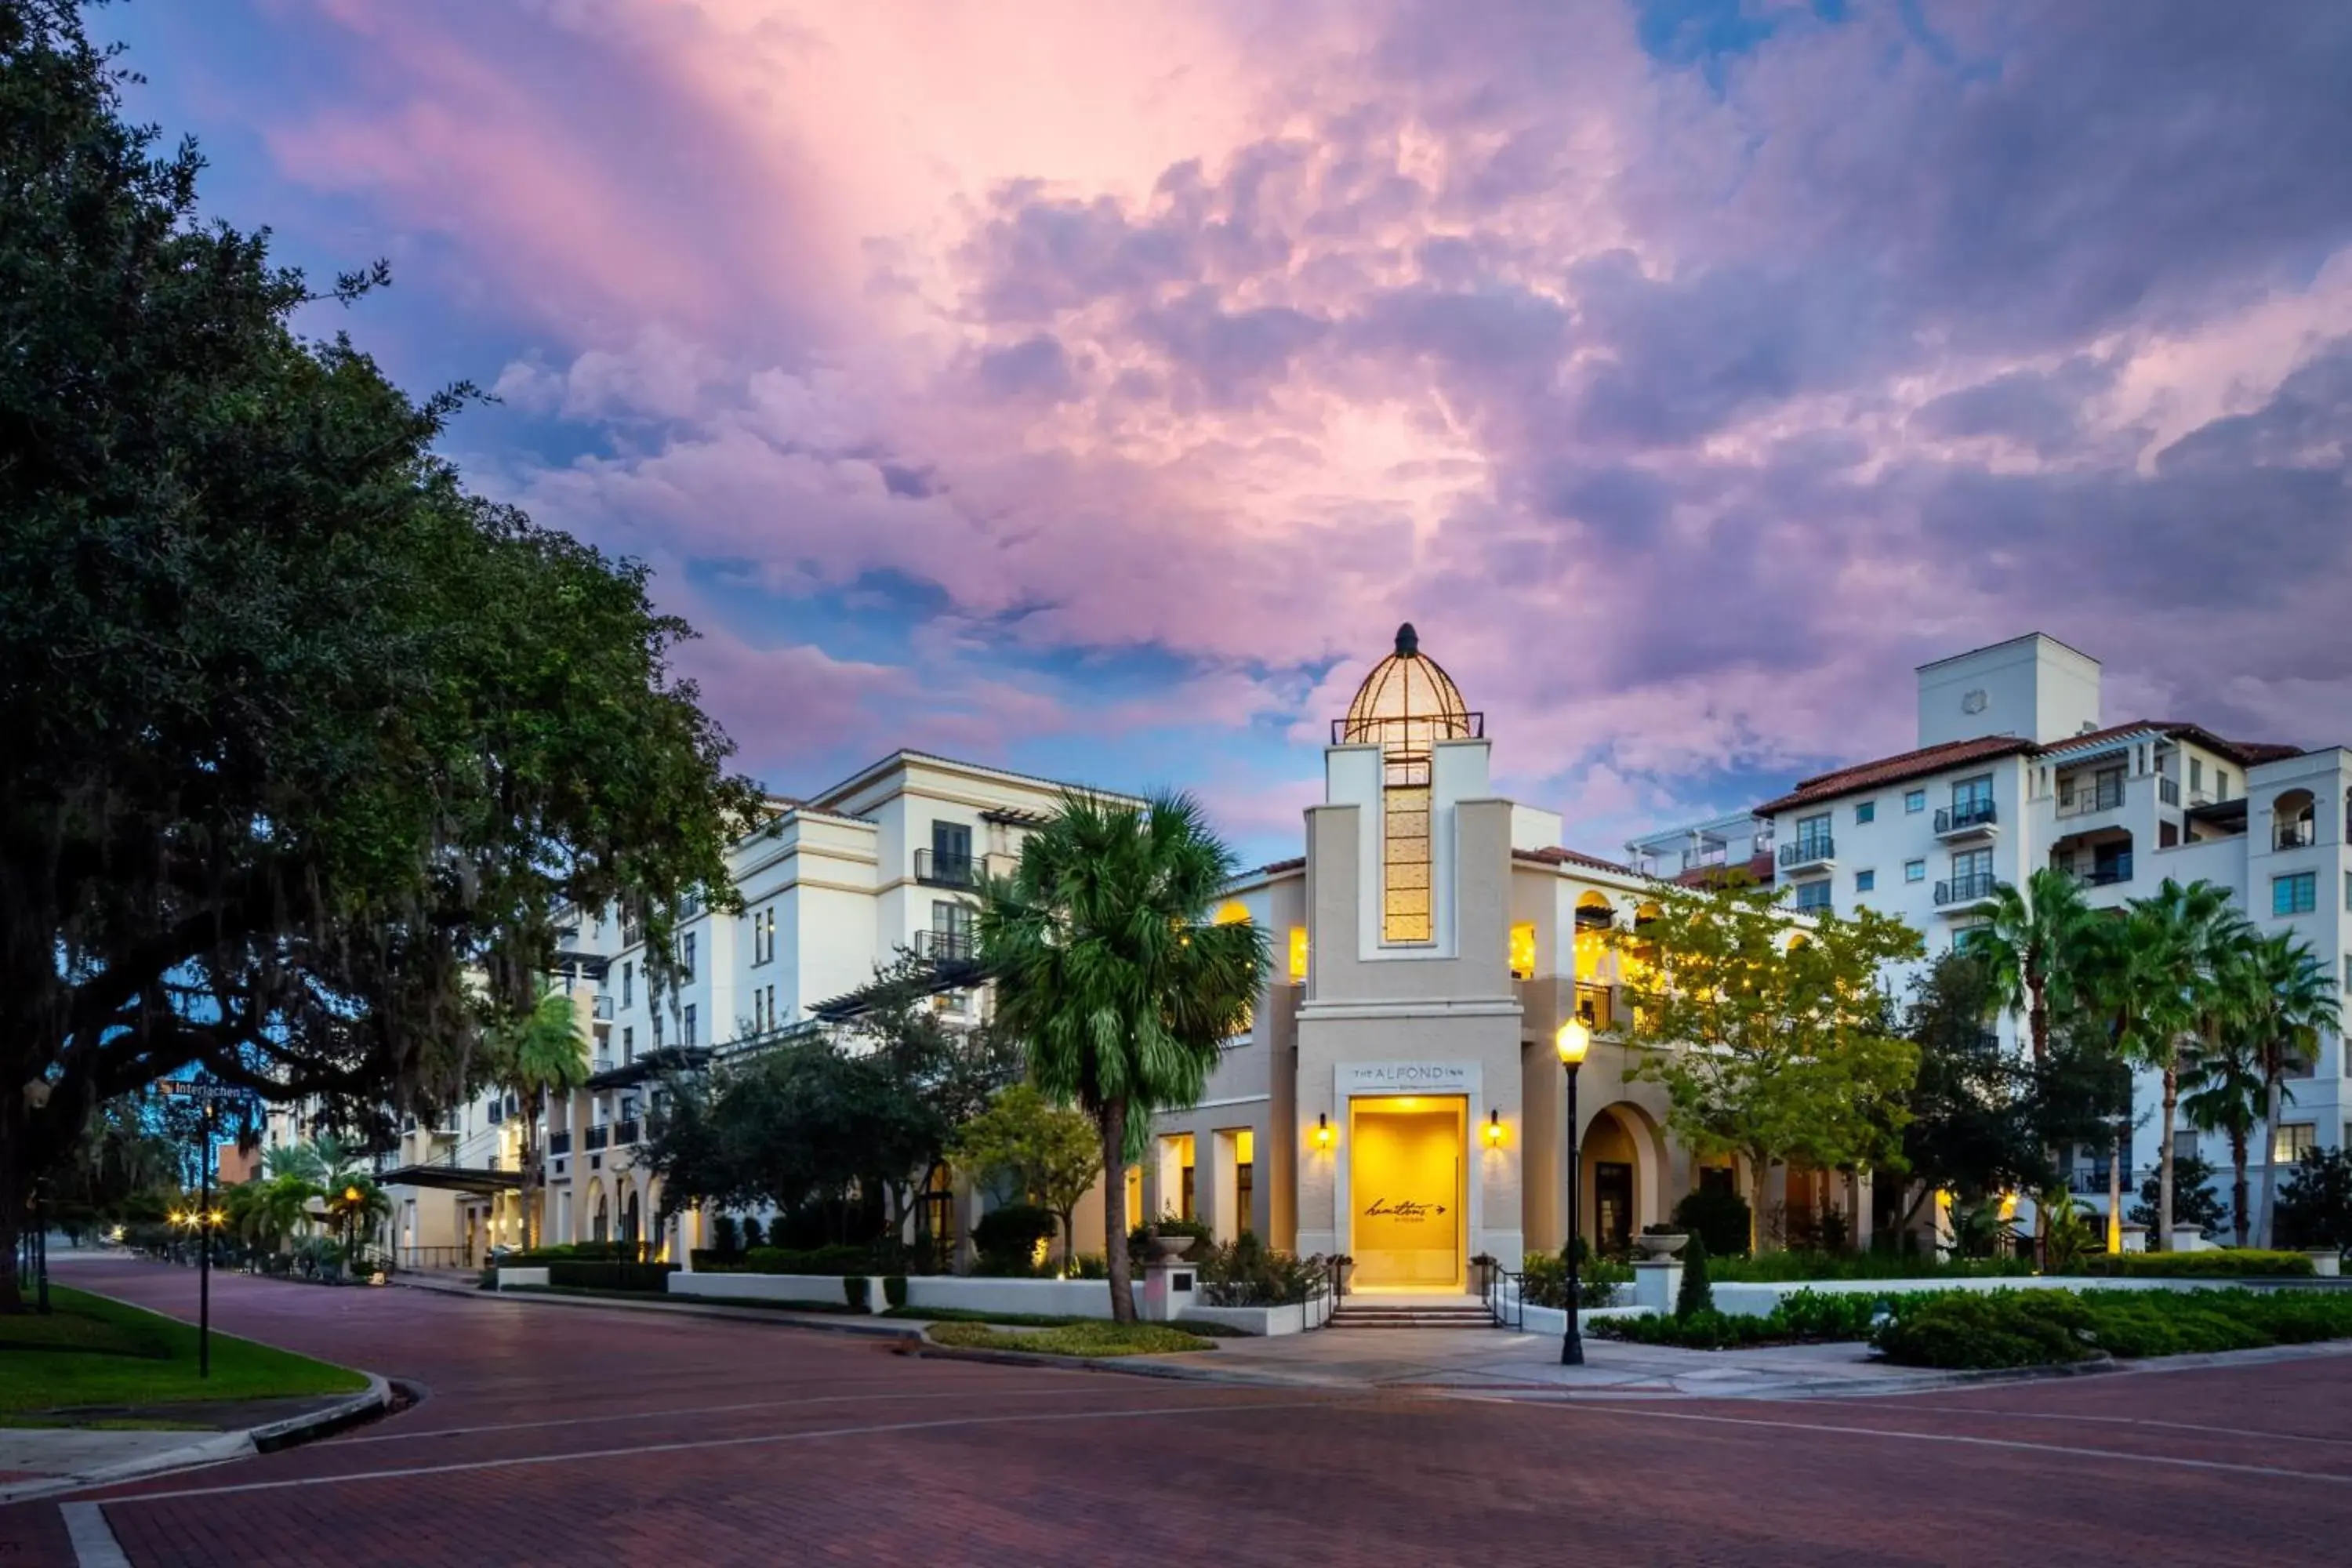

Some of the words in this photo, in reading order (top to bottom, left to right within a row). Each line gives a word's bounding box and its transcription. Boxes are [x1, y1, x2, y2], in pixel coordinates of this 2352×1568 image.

[1354, 1069, 1373, 1079] THE
[1376, 1067, 1444, 1080] ALFOND
[1446, 1068, 1464, 1076] INN
[176, 1082, 241, 1098] Interlachen
